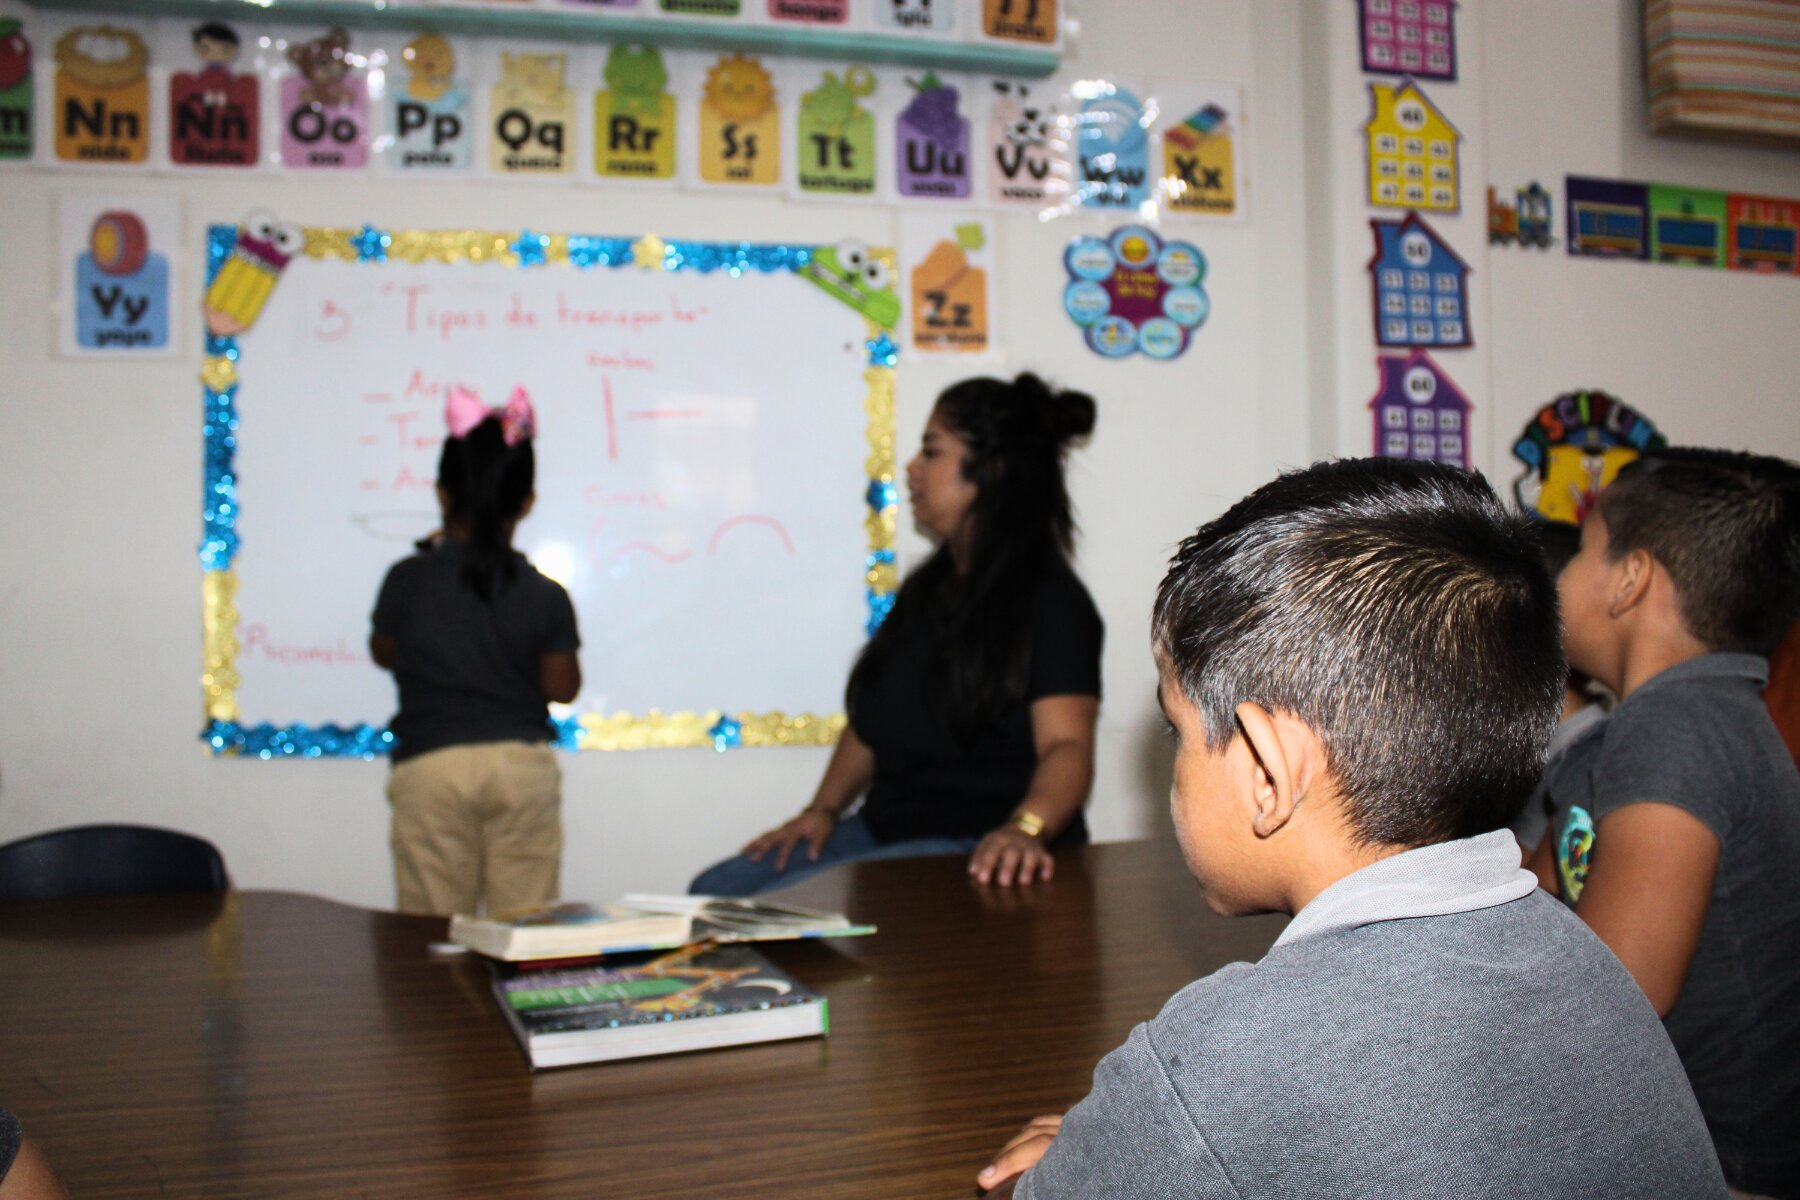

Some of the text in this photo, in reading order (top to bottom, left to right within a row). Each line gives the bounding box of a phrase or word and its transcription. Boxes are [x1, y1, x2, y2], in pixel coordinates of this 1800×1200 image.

[65, 98, 138, 138] Nn
[289, 104, 357, 143] Oo
[397, 102, 462, 146] Pp
[496, 109, 563, 151] Qq
[610, 115, 659, 152] Rr
[721, 123, 757, 159] Ss
[810, 133, 854, 169] Tt
[907, 141, 965, 176] Uu
[996, 145, 1048, 179] Vv
[1175, 155, 1222, 189] Xx
[91, 283, 149, 325] Yy
[924, 290, 972, 328] Zz
